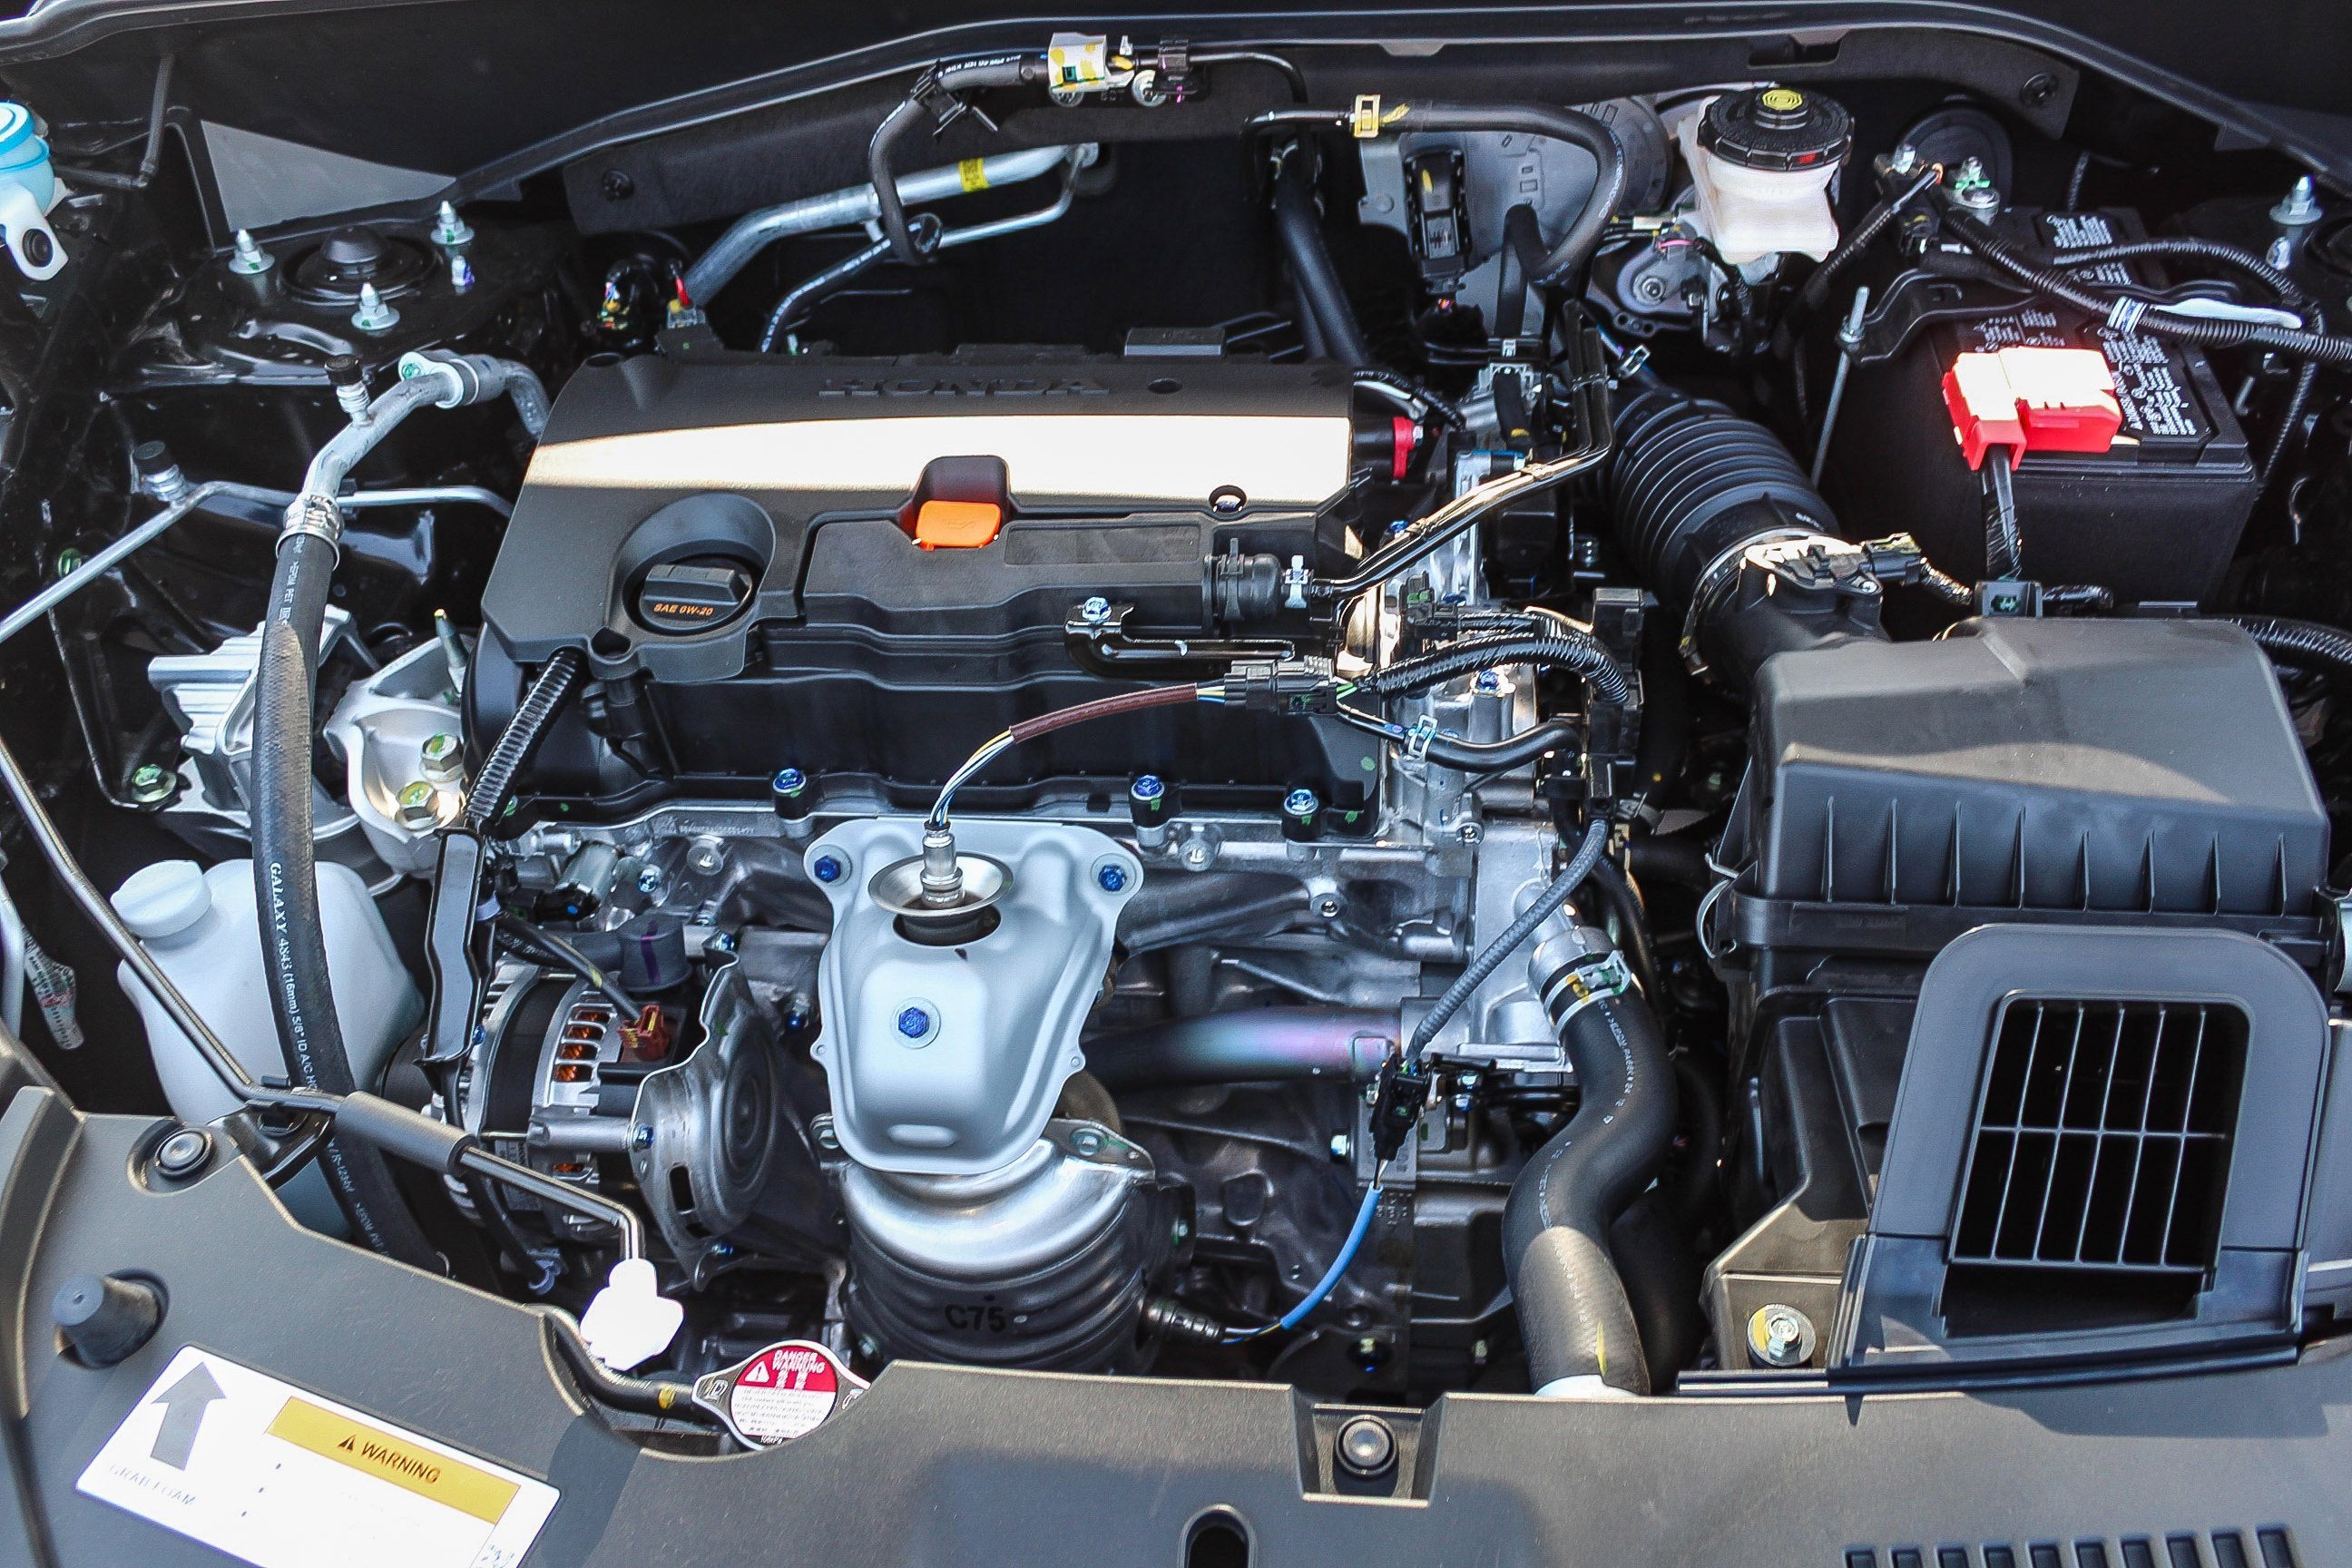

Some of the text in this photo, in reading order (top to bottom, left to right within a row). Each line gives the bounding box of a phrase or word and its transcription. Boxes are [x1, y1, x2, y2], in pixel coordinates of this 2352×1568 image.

[818, 377, 1110, 397] HONDA
[653, 603, 714, 616] SAE 0W-20
[270, 862, 289, 934] GALAXY
[282, 973, 300, 1014] (16mm)
[297, 1039, 308, 1053] ID
[300, 1054, 313, 1073] A/C
[945, 1304, 1006, 1333] C75
[773, 1349, 818, 1362] DANGER
[772, 1360, 827, 1374] WARNING
[360, 1441, 442, 1485] WARNING
